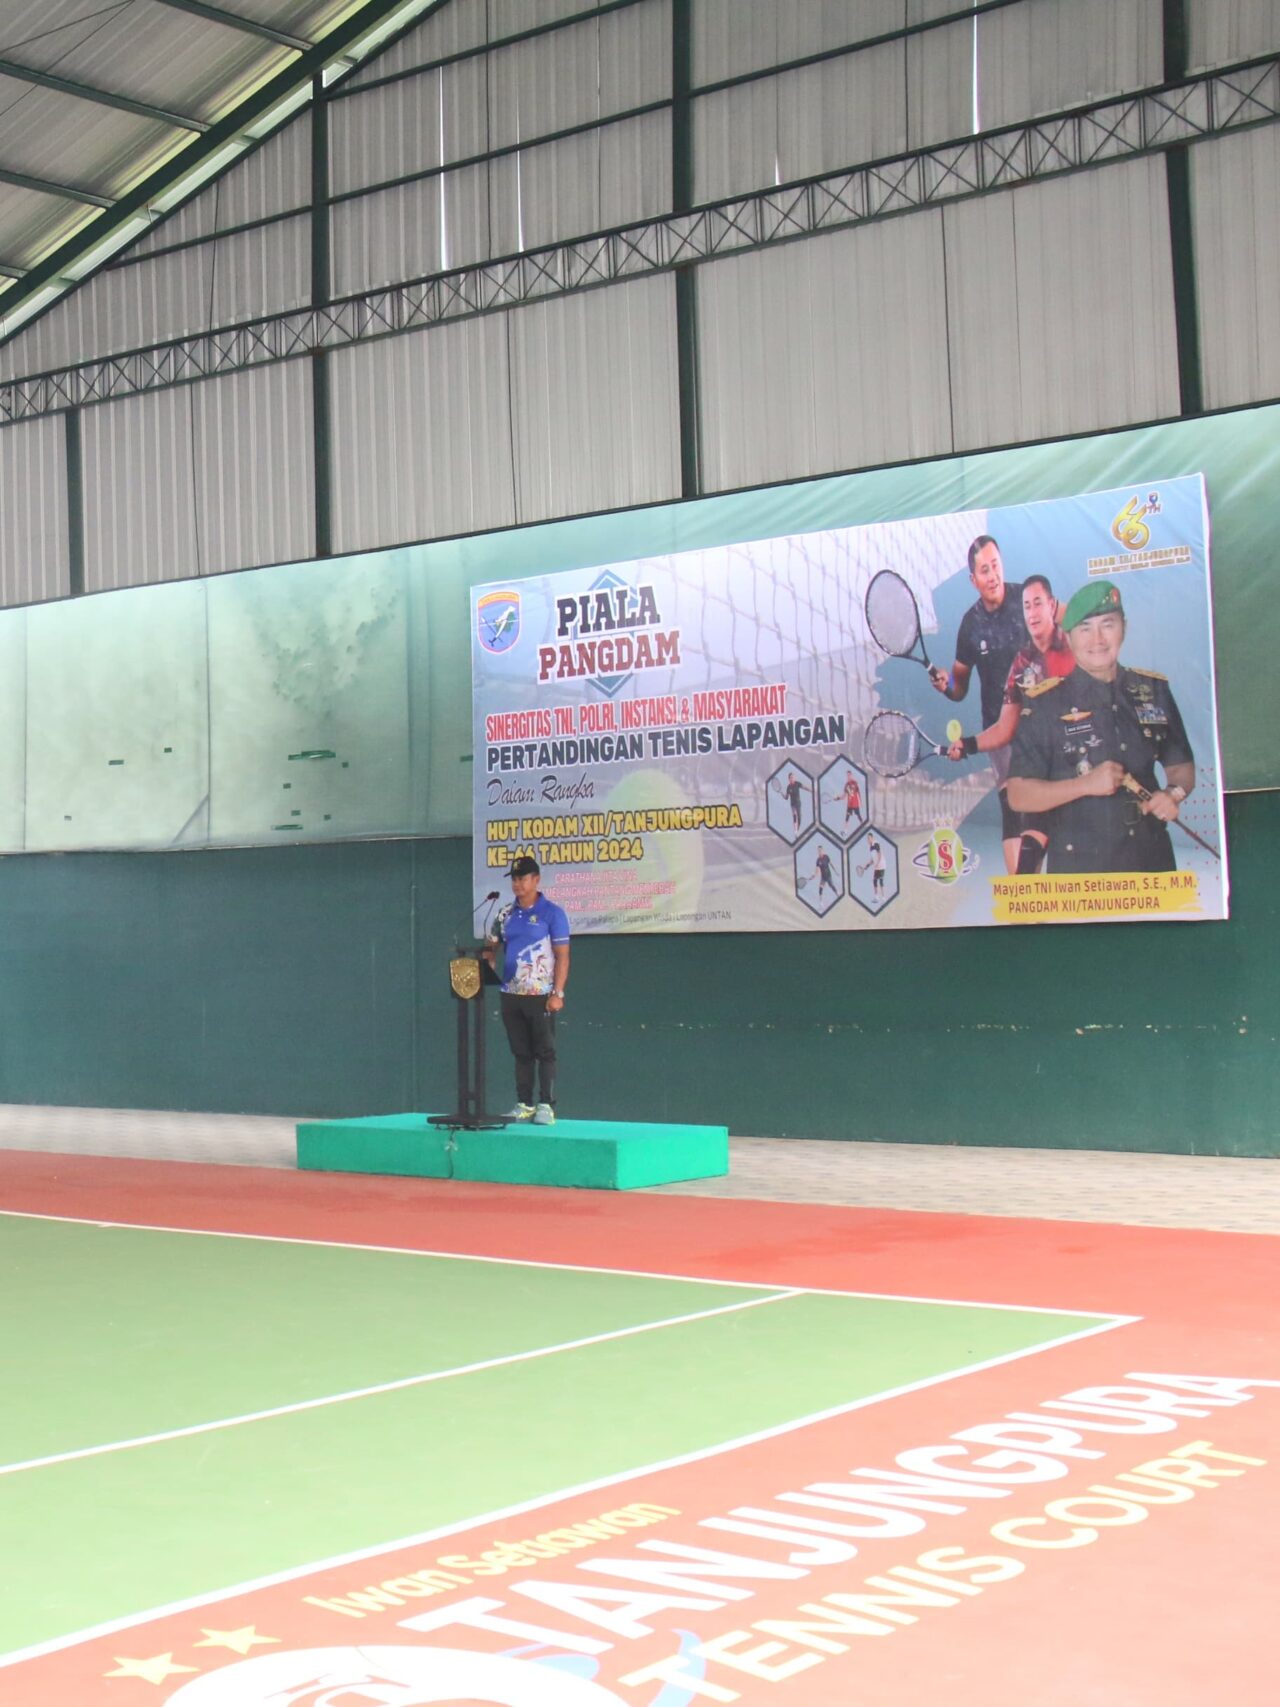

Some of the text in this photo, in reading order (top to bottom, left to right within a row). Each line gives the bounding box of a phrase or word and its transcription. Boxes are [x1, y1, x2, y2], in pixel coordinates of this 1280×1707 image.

[557, 586, 661, 636] PIALA
[539, 630, 681, 680] PANGDAM
[486, 685, 787, 742] SINERGITAS TNI, POLRI, INSTANSI & MASYARAKAT
[487, 715, 845, 771] PERTANDINGAN TENIS LAPANGAN
[540, 772, 594, 809] Rangka
[486, 804, 743, 842] HUT KODAM XII/TANJUNGPURA
[539, 840, 595, 865] TAHUN
[598, 837, 644, 861] 2024
[993, 882, 1032, 898] Mayjen
[1034, 881, 1052, 894] TNI
[1055, 881, 1081, 893] Iwan
[1084, 878, 1140, 892] Setiawan,
[1143, 877, 1167, 891] S.E.,
[1008, 896, 1160, 914] PANGDAM XII/TANJUNGPURA
[708, 911, 732, 920] UNTAN
[396, 1372, 1280, 1655] TANJUNGPURA
[304, 1570, 473, 1618] Iwan
[617, 1440, 1267, 1703] TENNIS COURT
